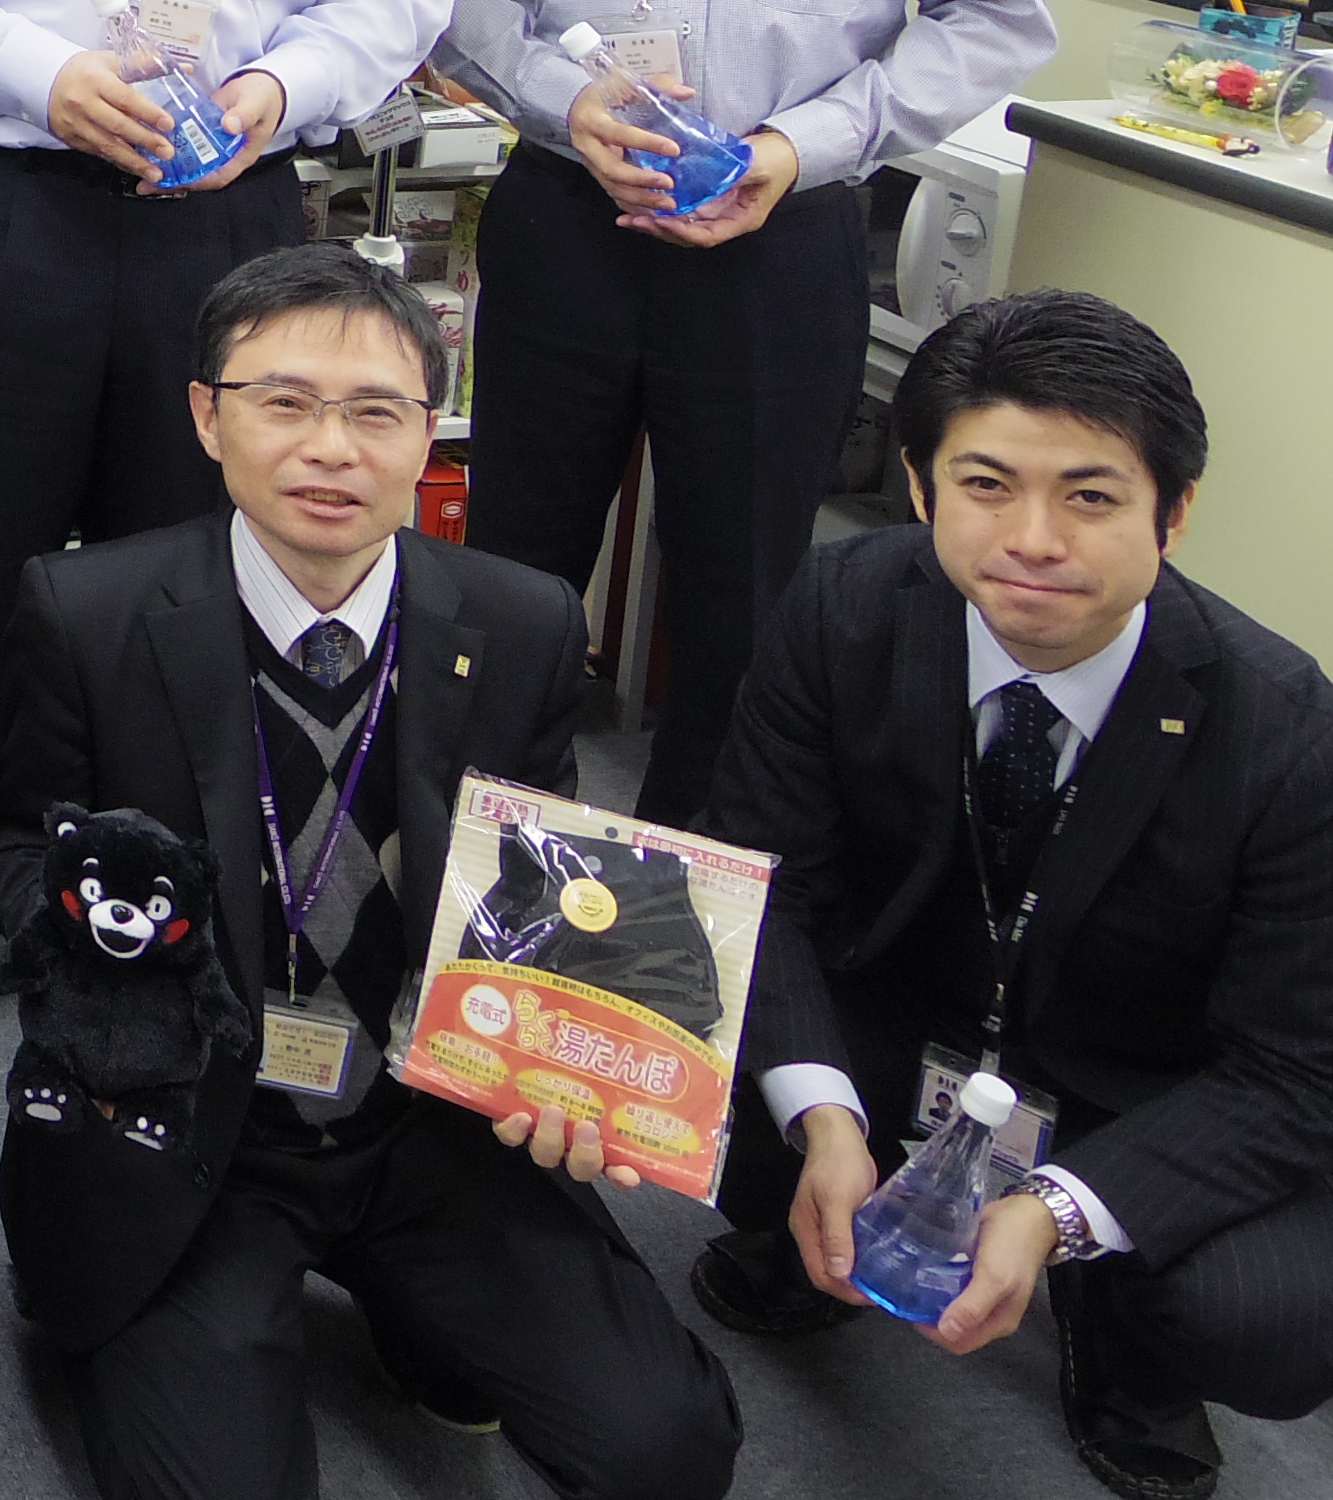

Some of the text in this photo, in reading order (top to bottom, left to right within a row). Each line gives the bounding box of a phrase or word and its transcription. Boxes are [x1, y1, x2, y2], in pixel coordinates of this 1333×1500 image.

[465, 996, 508, 1026] 充電式
[555, 1021, 678, 1093] 湯たんぽ
